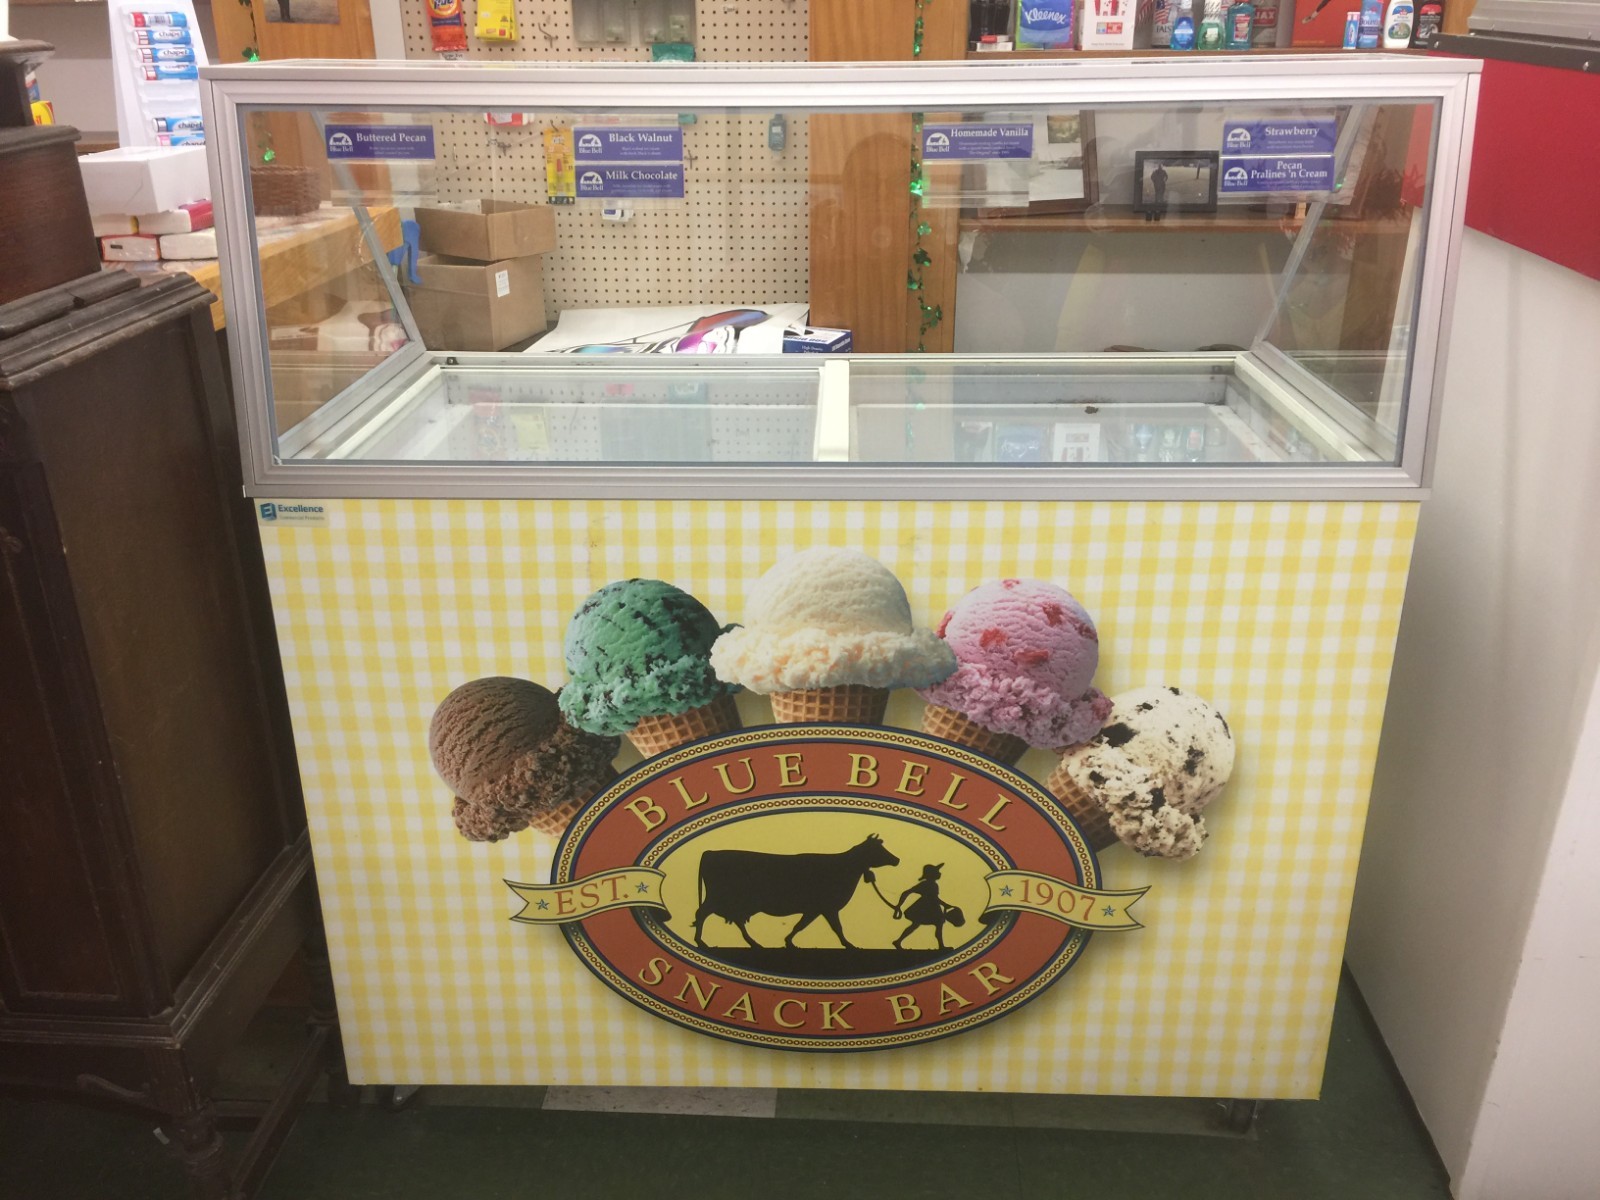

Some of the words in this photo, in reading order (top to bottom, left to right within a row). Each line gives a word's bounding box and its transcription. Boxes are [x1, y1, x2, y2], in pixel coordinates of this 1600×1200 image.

[1024, 8, 1066, 24] Kleenex
[951, 128, 997, 137] Homemade
[1000, 128, 1029, 137] Vanilla
[1265, 126, 1320, 138] Strawberry
[356, 133, 396, 142] Buttered
[399, 133, 427, 142] Pecan
[609, 133, 635, 142] Black
[638, 133, 673, 142] Walnut
[1277, 160, 1302, 170] Pecan
[605, 170, 629, 180] Milk
[631, 170, 678, 180] Chocolate
[1251, 169, 1286, 179] Pralines
[1288, 170, 1297, 178] 'n
[1299, 169, 1328, 178] Cream
[278, 504, 324, 513] Excellence
[624, 752, 808, 832] BLUE
[846, 753, 1012, 832] BELL
[554, 874, 629, 915] EST.
[1019, 879, 1096, 921] 1907
[638, 957, 854, 1030] SNACK
[885, 962, 1015, 1025] BAR
